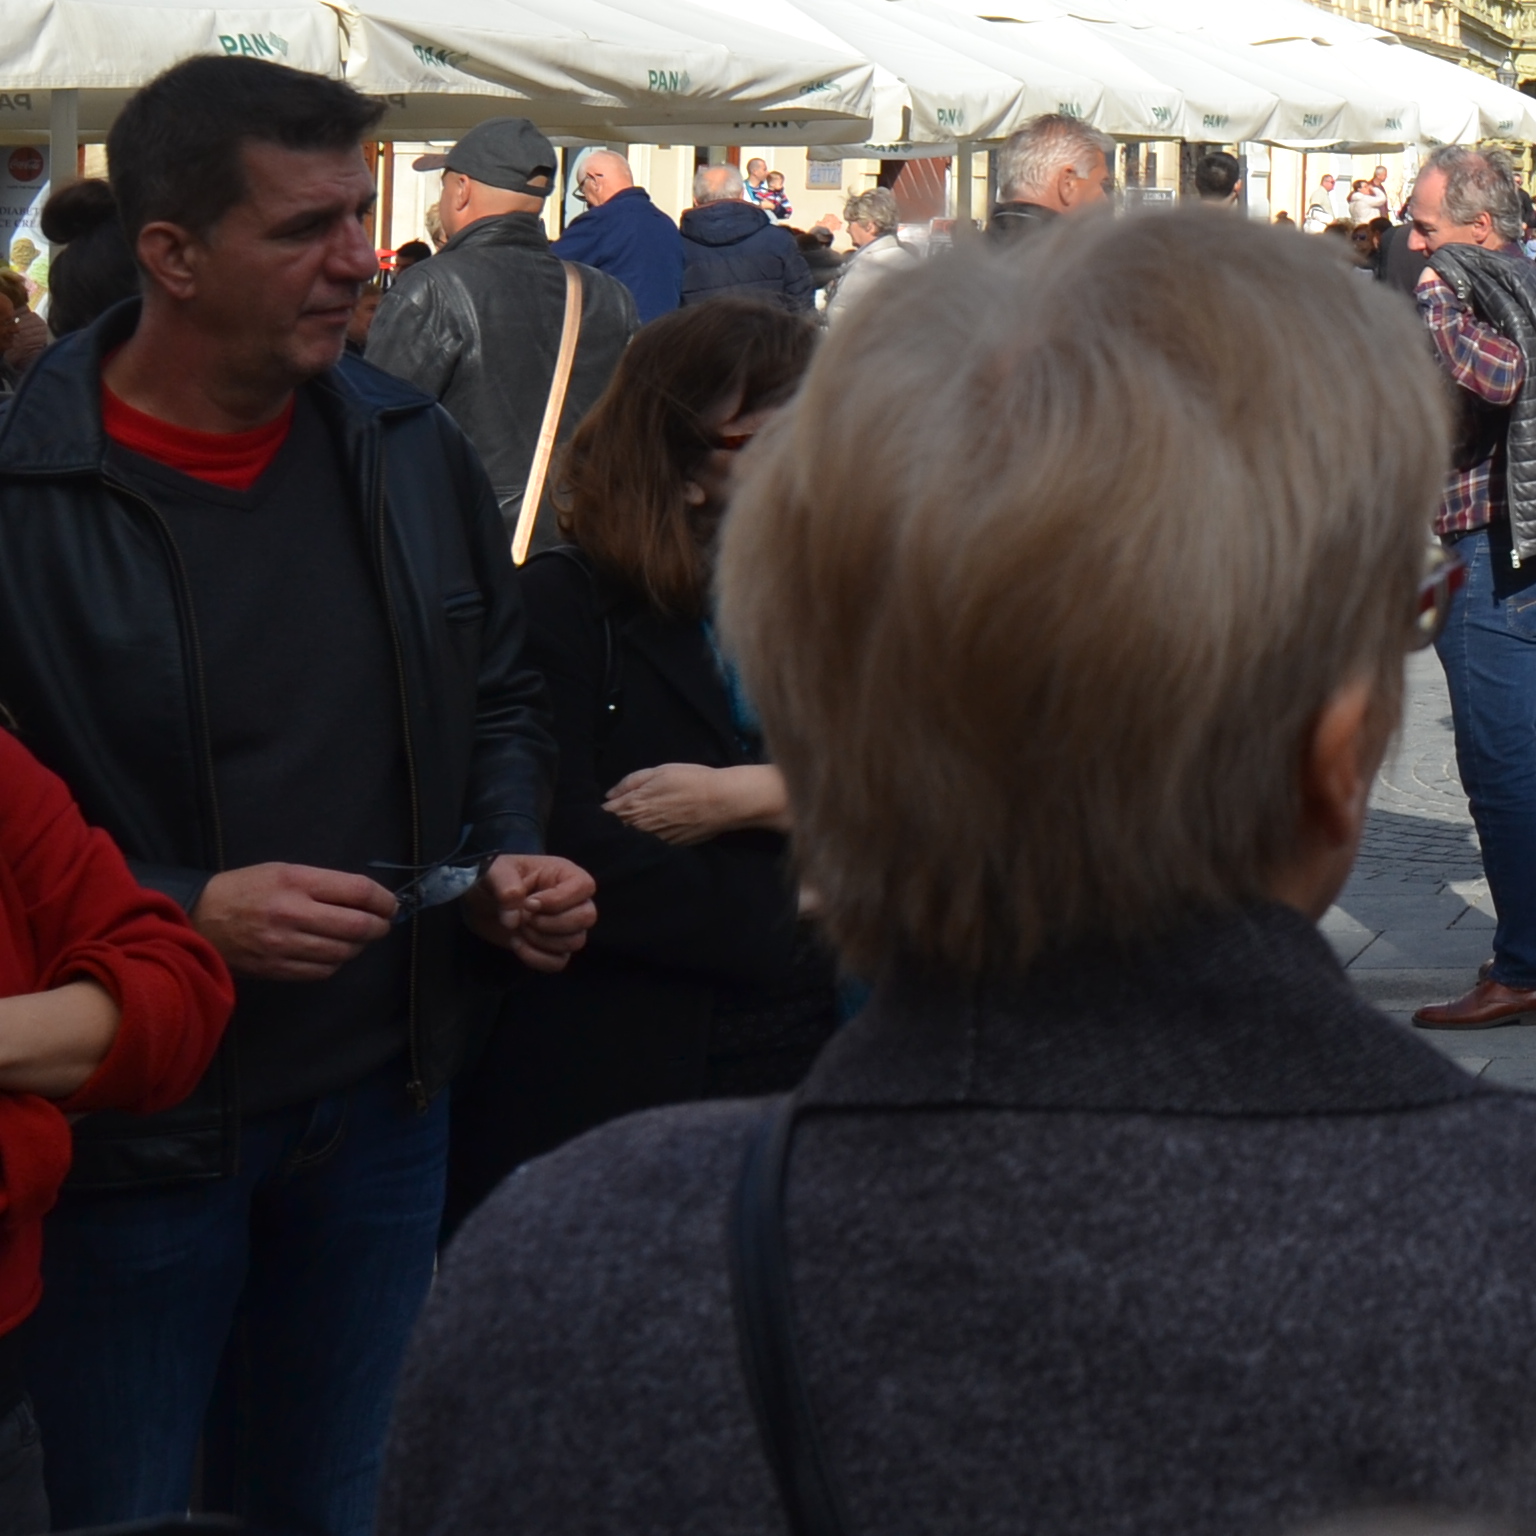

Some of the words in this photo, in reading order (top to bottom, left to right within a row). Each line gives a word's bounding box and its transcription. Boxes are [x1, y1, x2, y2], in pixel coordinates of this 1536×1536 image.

[219, 34, 275, 56] PAN
[648, 69, 680, 91] PAN
[937, 108, 957, 126] PAN
